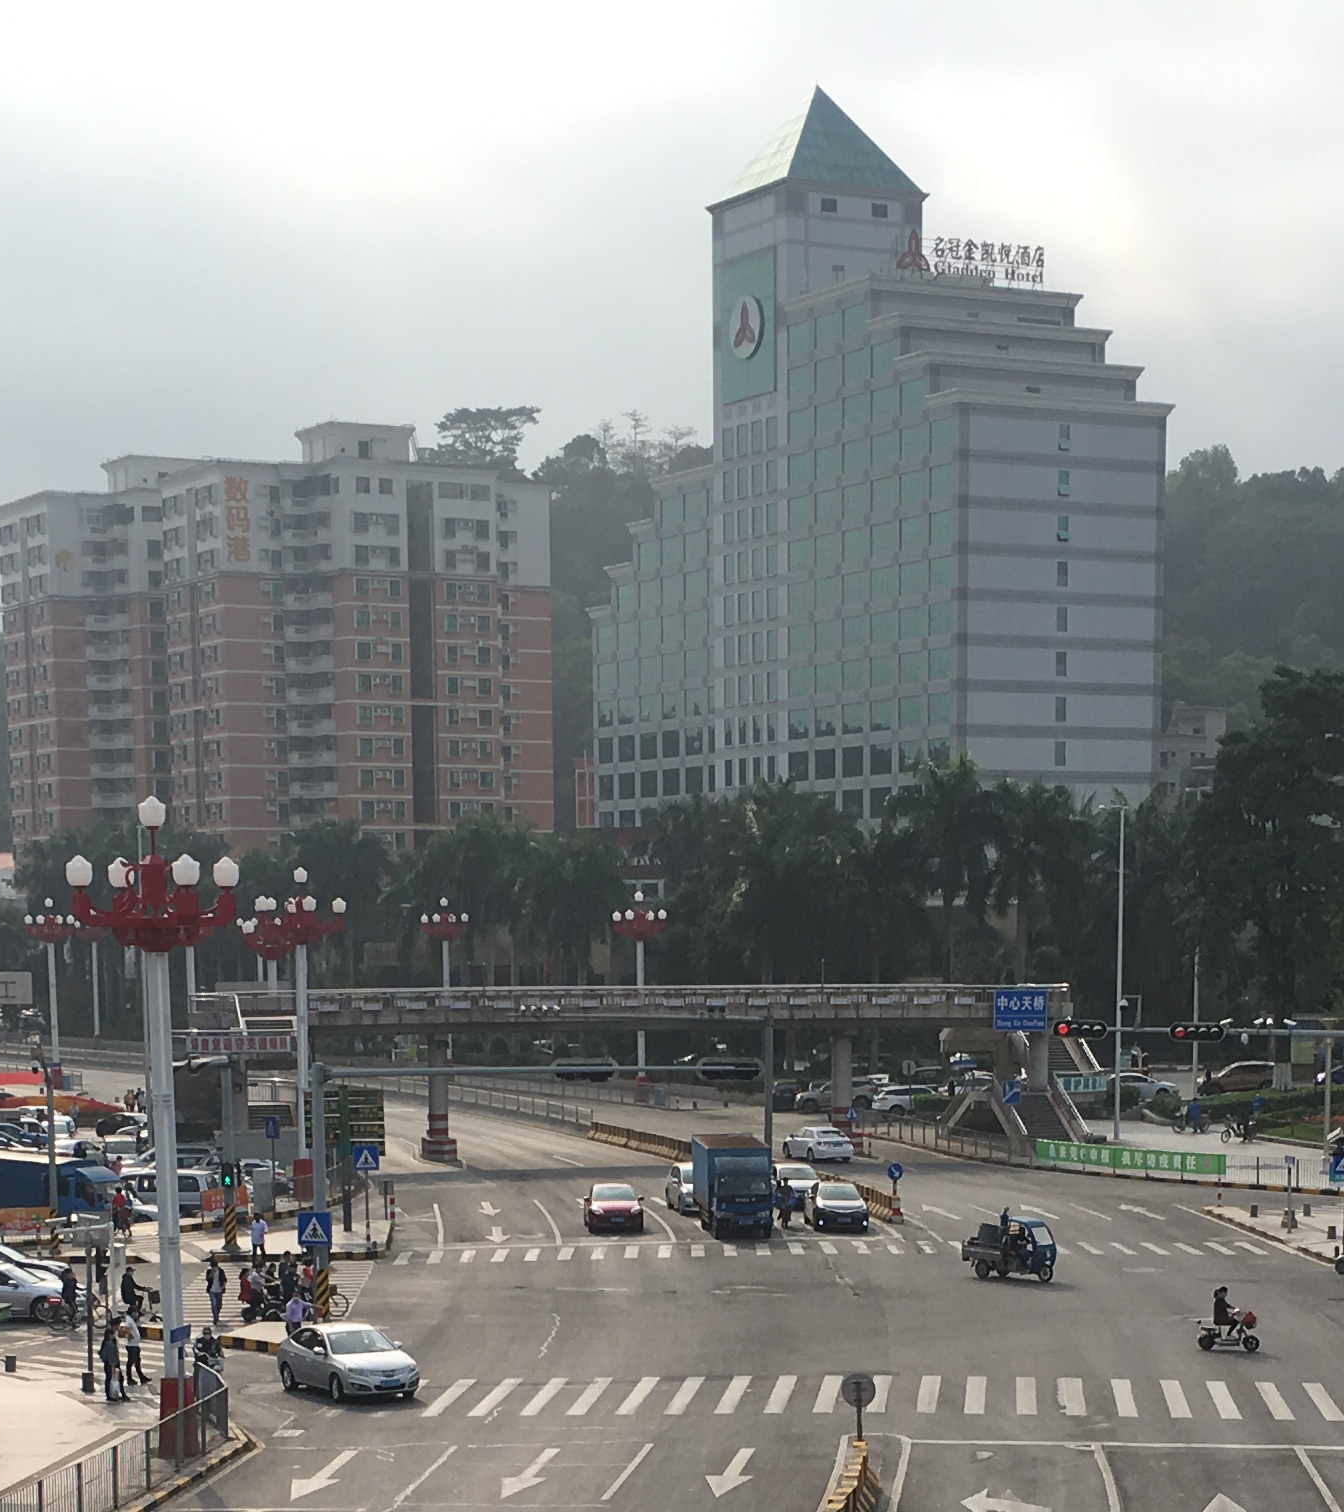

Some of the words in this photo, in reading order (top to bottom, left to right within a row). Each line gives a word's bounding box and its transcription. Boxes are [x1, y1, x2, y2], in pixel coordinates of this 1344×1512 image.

[931, 236, 1045, 268] 名冠金凯悦酒店
[934, 261, 996, 280] Gladden
[1005, 268, 1044, 284] Hotel
[997, 995, 1045, 1011] 中心天桥
